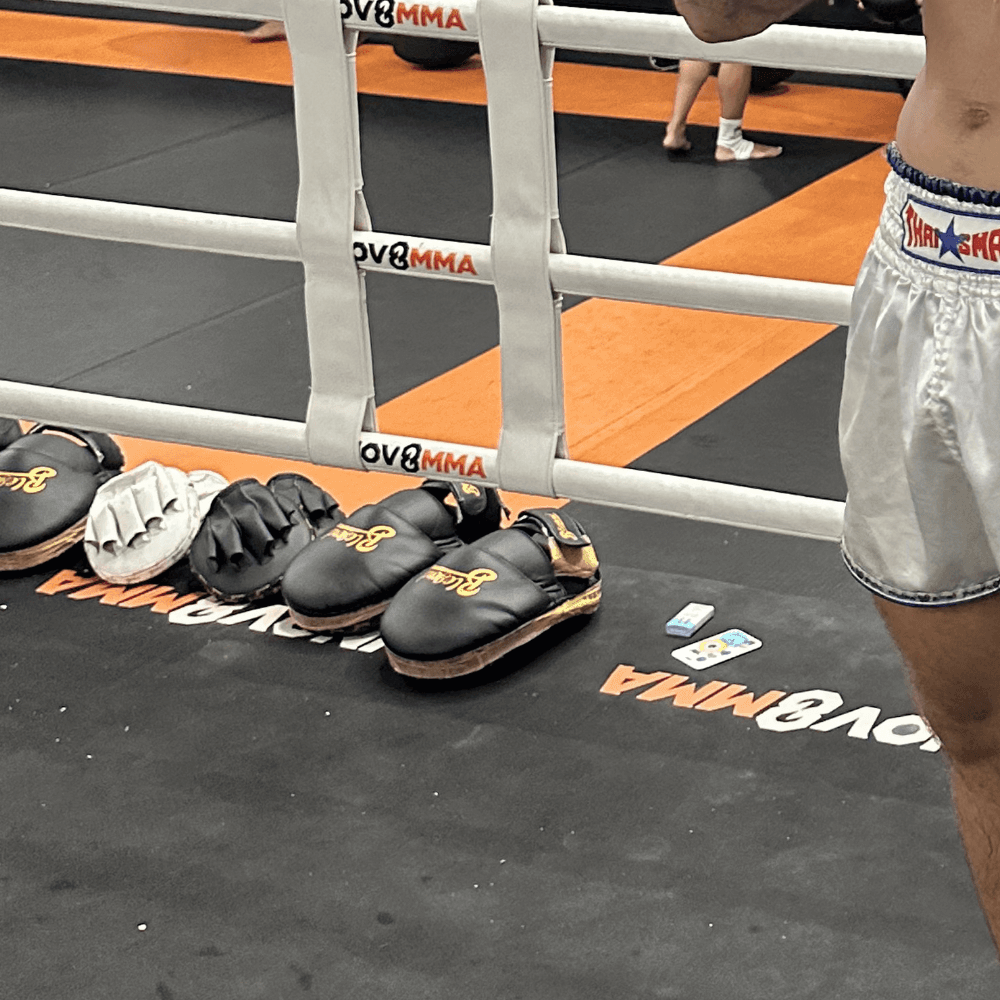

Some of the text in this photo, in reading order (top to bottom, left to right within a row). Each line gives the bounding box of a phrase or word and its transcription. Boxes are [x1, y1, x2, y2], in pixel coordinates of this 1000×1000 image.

[905, 203, 939, 249] THAI
[353, 241, 478, 276] OV8MMA
[360, 442, 487, 479] OV8MMA
[600, 665, 942, 753] OV8MMA
